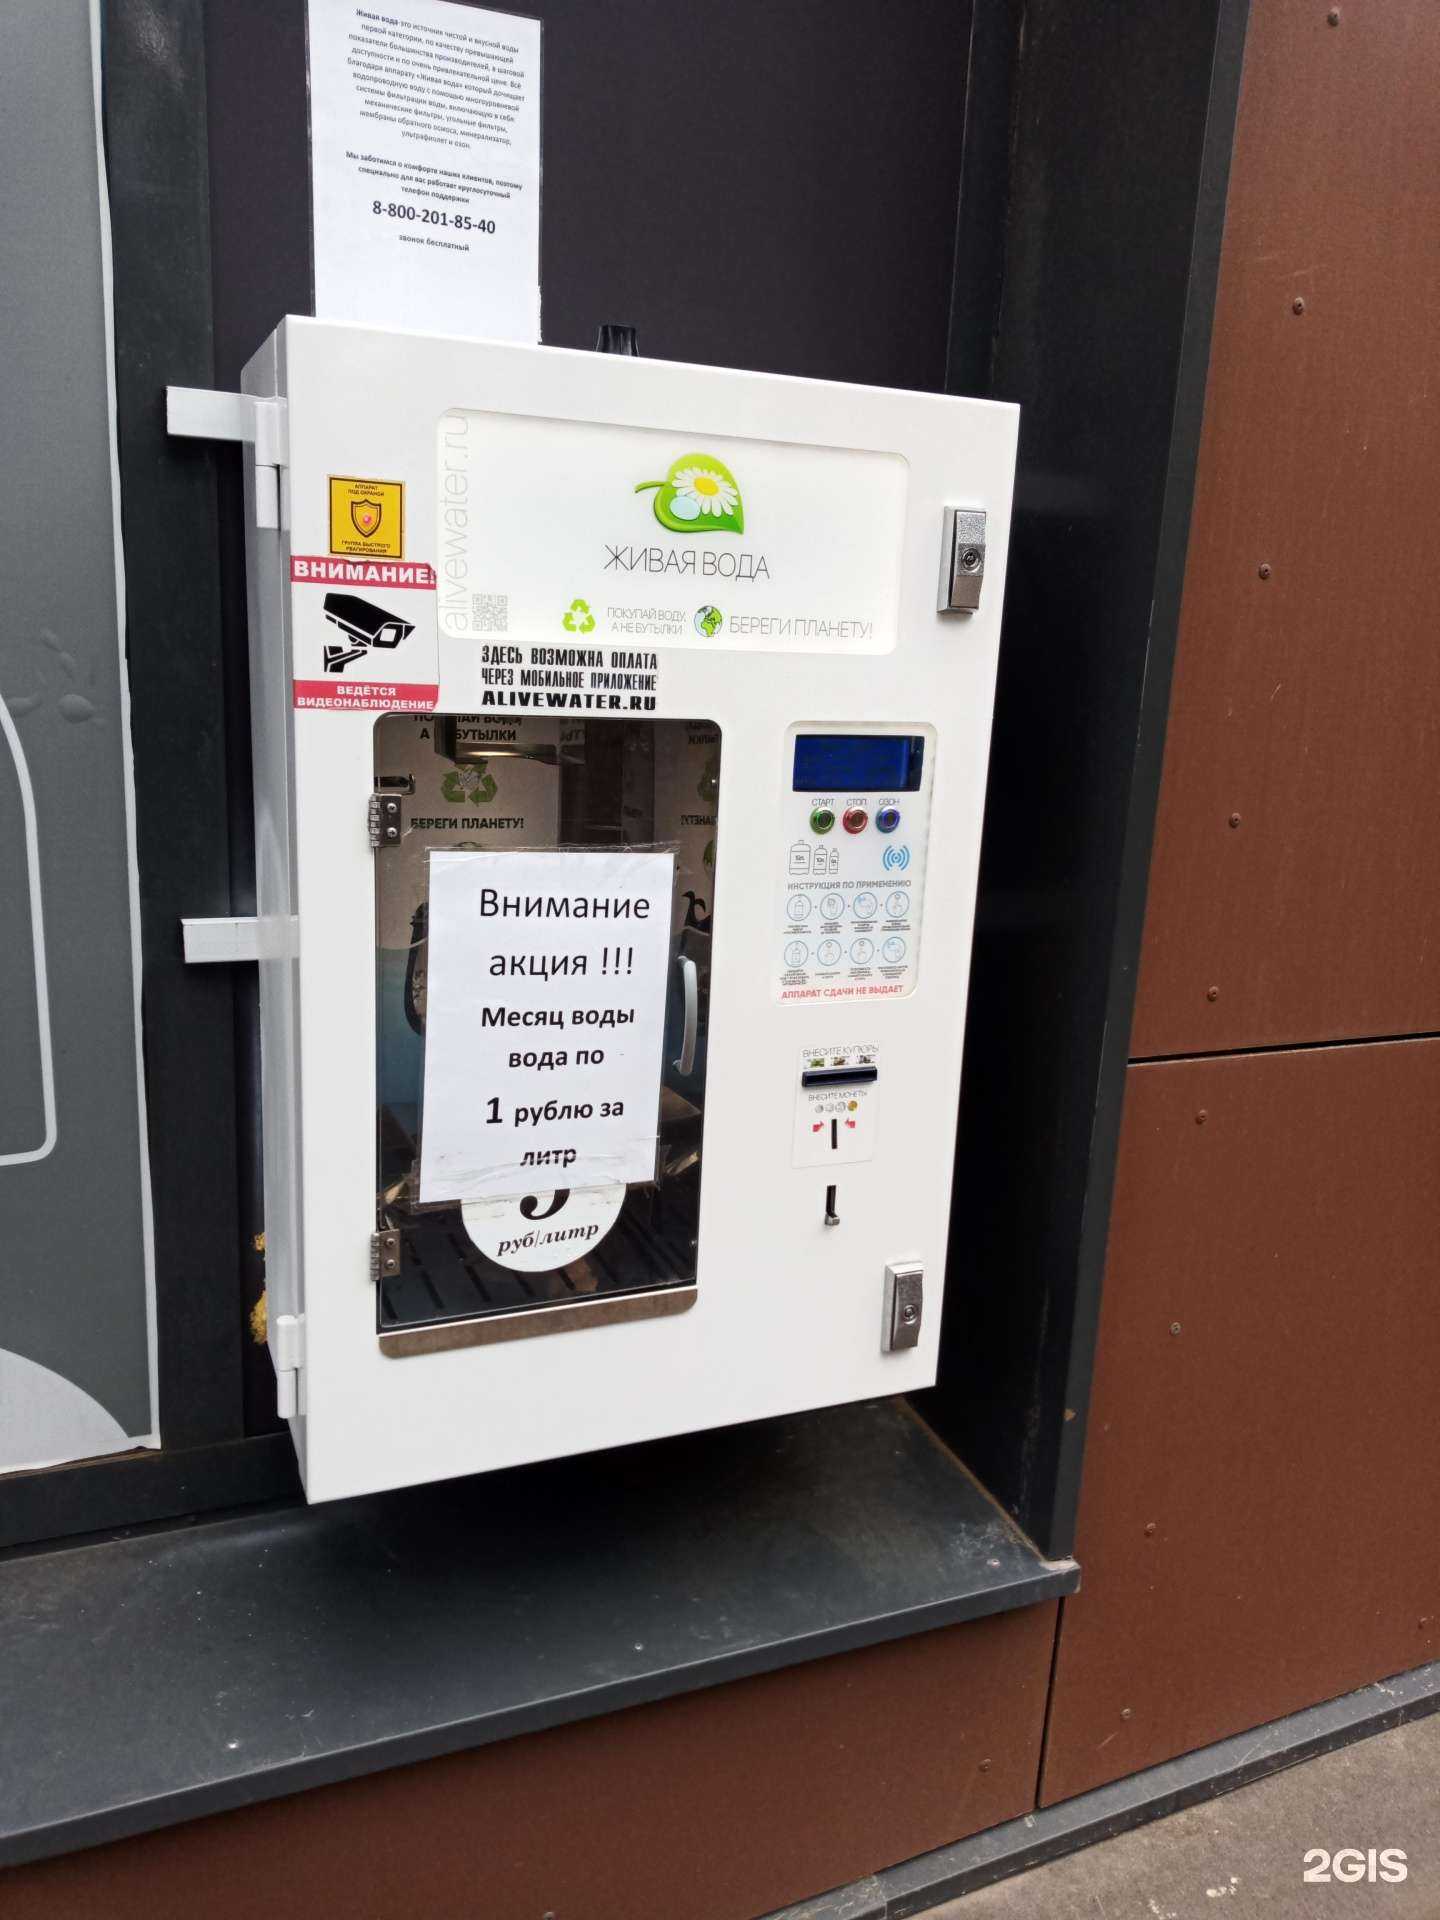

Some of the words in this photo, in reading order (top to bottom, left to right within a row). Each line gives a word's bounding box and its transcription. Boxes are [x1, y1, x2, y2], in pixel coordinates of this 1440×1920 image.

[356, 8, 380, 21] Живая
[412, 24, 443, 36] источник
[444, 31, 467, 41] чистой
[474, 38, 500, 49] вкусной
[501, 44, 519, 53] воды
[361, 23, 386, 35] первой
[387, 30, 423, 44] категории,
[435, 41, 463, 54] качеству
[348, 33, 388, 47] показатели
[389, 41, 433, 59] большинства
[434, 52, 490, 72] производителей,
[497, 67, 524, 78] шаговой
[352, 47, 395, 61] доступности
[411, 60, 431, 70] очень
[432, 65, 490, 82] привлекательной
[347, 57, 383, 71] Благодаря
[384, 66, 414, 79] аппарату
[464, 84, 492, 95] который
[352, 72, 408, 89] водопроводную
[409, 83, 425, 93] воду
[431, 89, 464, 101] помощью
[465, 96, 520, 112] многоуровневой
[356, 85, 385, 96] системы
[386, 91, 427, 105] фильтрации
[449, 104, 492, 119] включающую
[359, 110, 396, 123] мембраны
[397, 116, 432, 130] обратного
[364, 98, 412, 114] механические
[446, 115, 476, 127] угольные
[401, 130, 448, 145] ультрафиолет
[345, 151, 359, 160] Мы
[360, 154, 396, 167] заботимся
[403, 162, 438, 175] комфорте
[439, 169, 460, 179] наших
[496, 179, 523, 191] поэтому
[358, 166, 399, 180] специально
[400, 174, 413, 182] для
[426, 179, 457, 190] работает
[458, 184, 511, 199] круглосуточный
[401, 185, 430, 196] телефон
[431, 190, 470, 204] поддержки
[372, 200, 496, 235] 8-800-201-85-40
[398, 234, 424, 245] звонок
[426, 237, 470, 251] бесплатный
[354, 483, 379, 491] АППАРАТ
[438, 414, 469, 631] alivewater.ru
[293, 560, 437, 585] ВНИМАНИЕ!
[602, 544, 697, 575] ЖИВАЯ
[701, 550, 771, 582] ВОДА
[607, 606, 658, 620] ПОКУПАЙ
[729, 615, 793, 635] БЕРЕГИ
[794, 619, 873, 639] ПЛАНЕТУ!
[481, 645, 523, 665] ЗДЕСЬ
[531, 647, 604, 668] ВОЗМОЖНА
[611, 651, 658, 670] ОПЛАТА
[481, 667, 514, 686] ЧЕРЕЗ
[520, 669, 585, 688] МОБИЛЬНОЕ
[590, 672, 657, 691] ПРИЛОЖЕНИЕ
[297, 697, 434, 710] ВИДЕОНАБЛЮДЕНИЕ
[481, 690, 657, 710] ALIVEWATER.RU
[420, 728, 430, 739] А
[456, 729, 517, 741] БУТЫЛКИ
[811, 798, 835, 807] СТАРТ
[846, 798, 868, 806] СТОП
[411, 818, 458, 829] БЕРЕГИ
[461, 817, 525, 829] ПЛАНЕТУ!
[788, 881, 841, 890] ИНСТРУКЦИЯ
[856, 879, 912, 888] ПРИМЕНЕНИЮ
[480, 888, 651, 919] Внимание
[489, 952, 588, 981] акция
[599, 947, 635, 976] !!!
[781, 989, 821, 999] АППАРАТ
[823, 987, 854, 997] СДАЧИ
[856, 987, 868, 995] НЕ
[868, 984, 904, 994] ВЫДАЕТ
[481, 1006, 564, 1029] Месяц
[571, 1006, 635, 1028] воды
[508, 1049, 568, 1070] вода
[575, 1048, 605, 1066] по
[485, 1097, 504, 1124] 1
[514, 1101, 593, 1127] рублю
[600, 1102, 625, 1118] за
[519, 1146, 577, 1168] литр
[496, 1223, 600, 1257] руб/литр
